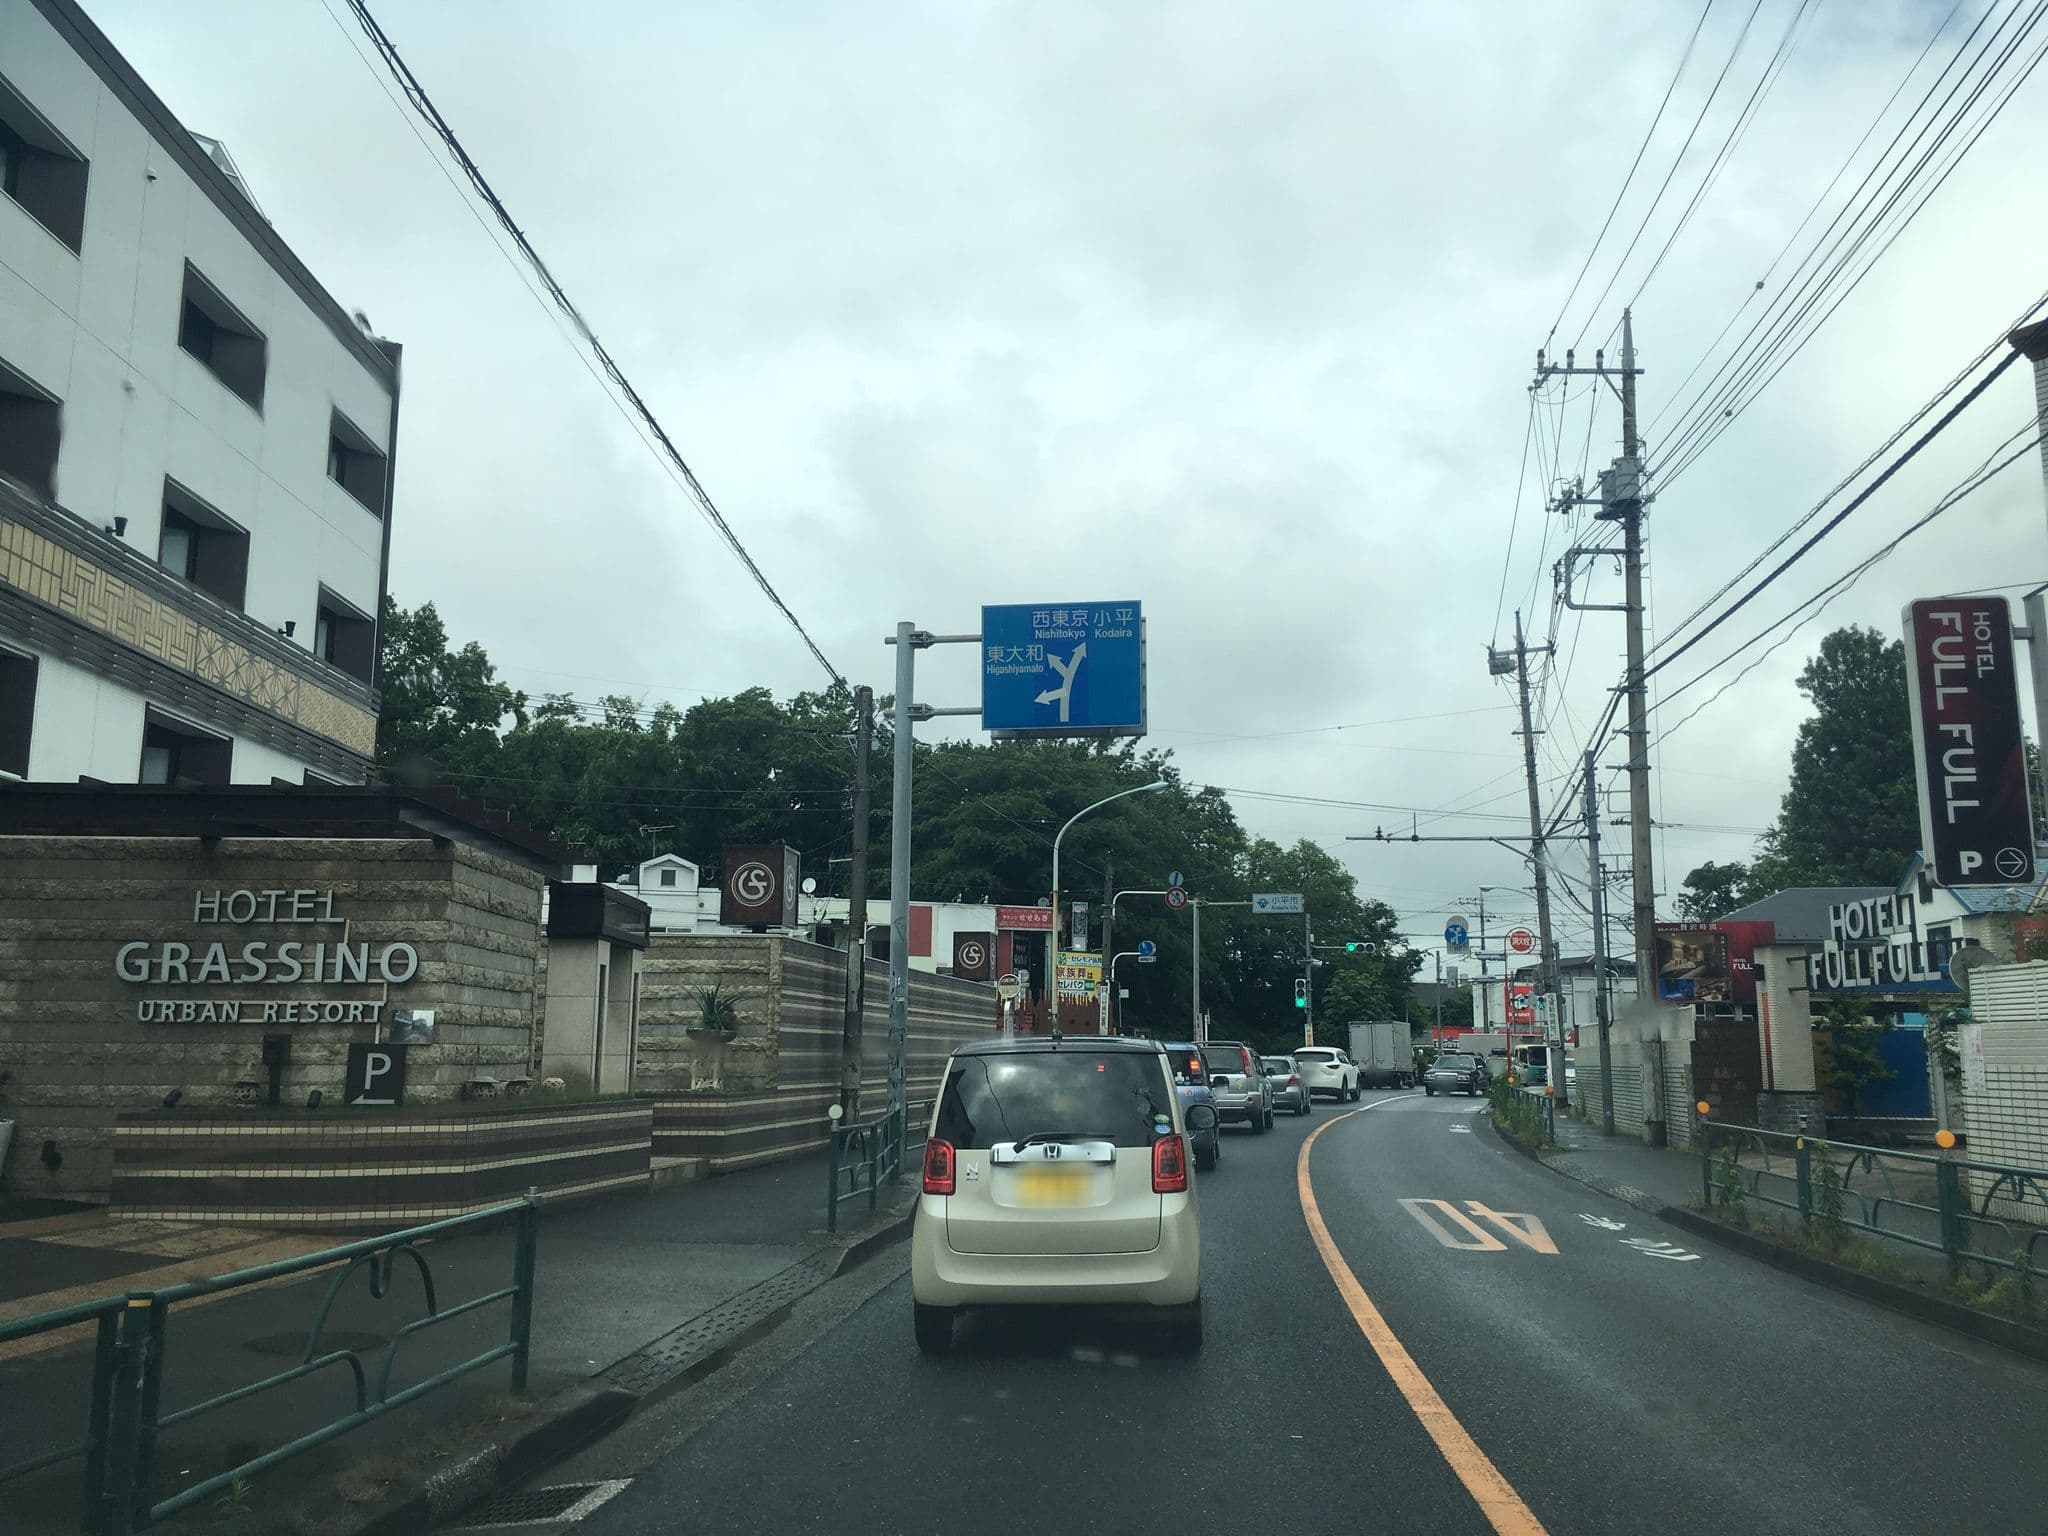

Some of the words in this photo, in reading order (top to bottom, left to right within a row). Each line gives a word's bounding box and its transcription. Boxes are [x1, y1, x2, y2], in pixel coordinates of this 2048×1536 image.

[1032, 609, 1089, 628] 西東京
[1093, 608, 1134, 627] 小平
[1035, 629, 1086, 640] Nishitokyo
[1095, 628, 1132, 639] Kodaira
[987, 644, 1044, 664] 東大和
[1929, 612, 1968, 710] FULL
[1972, 612, 1994, 678] HOTEL
[987, 664, 1044, 676] Higashiyamato
[1939, 723, 1980, 824] FULL
[1959, 850, 1983, 875] P
[194, 890, 345, 923] HOTEL
[1829, 894, 1912, 942] HOTEL
[116, 941, 419, 984] GRASSINO
[138, 1000, 240, 1023] URBAN
[263, 1001, 385, 1023] RESORT
[364, 1053, 392, 1090] P
